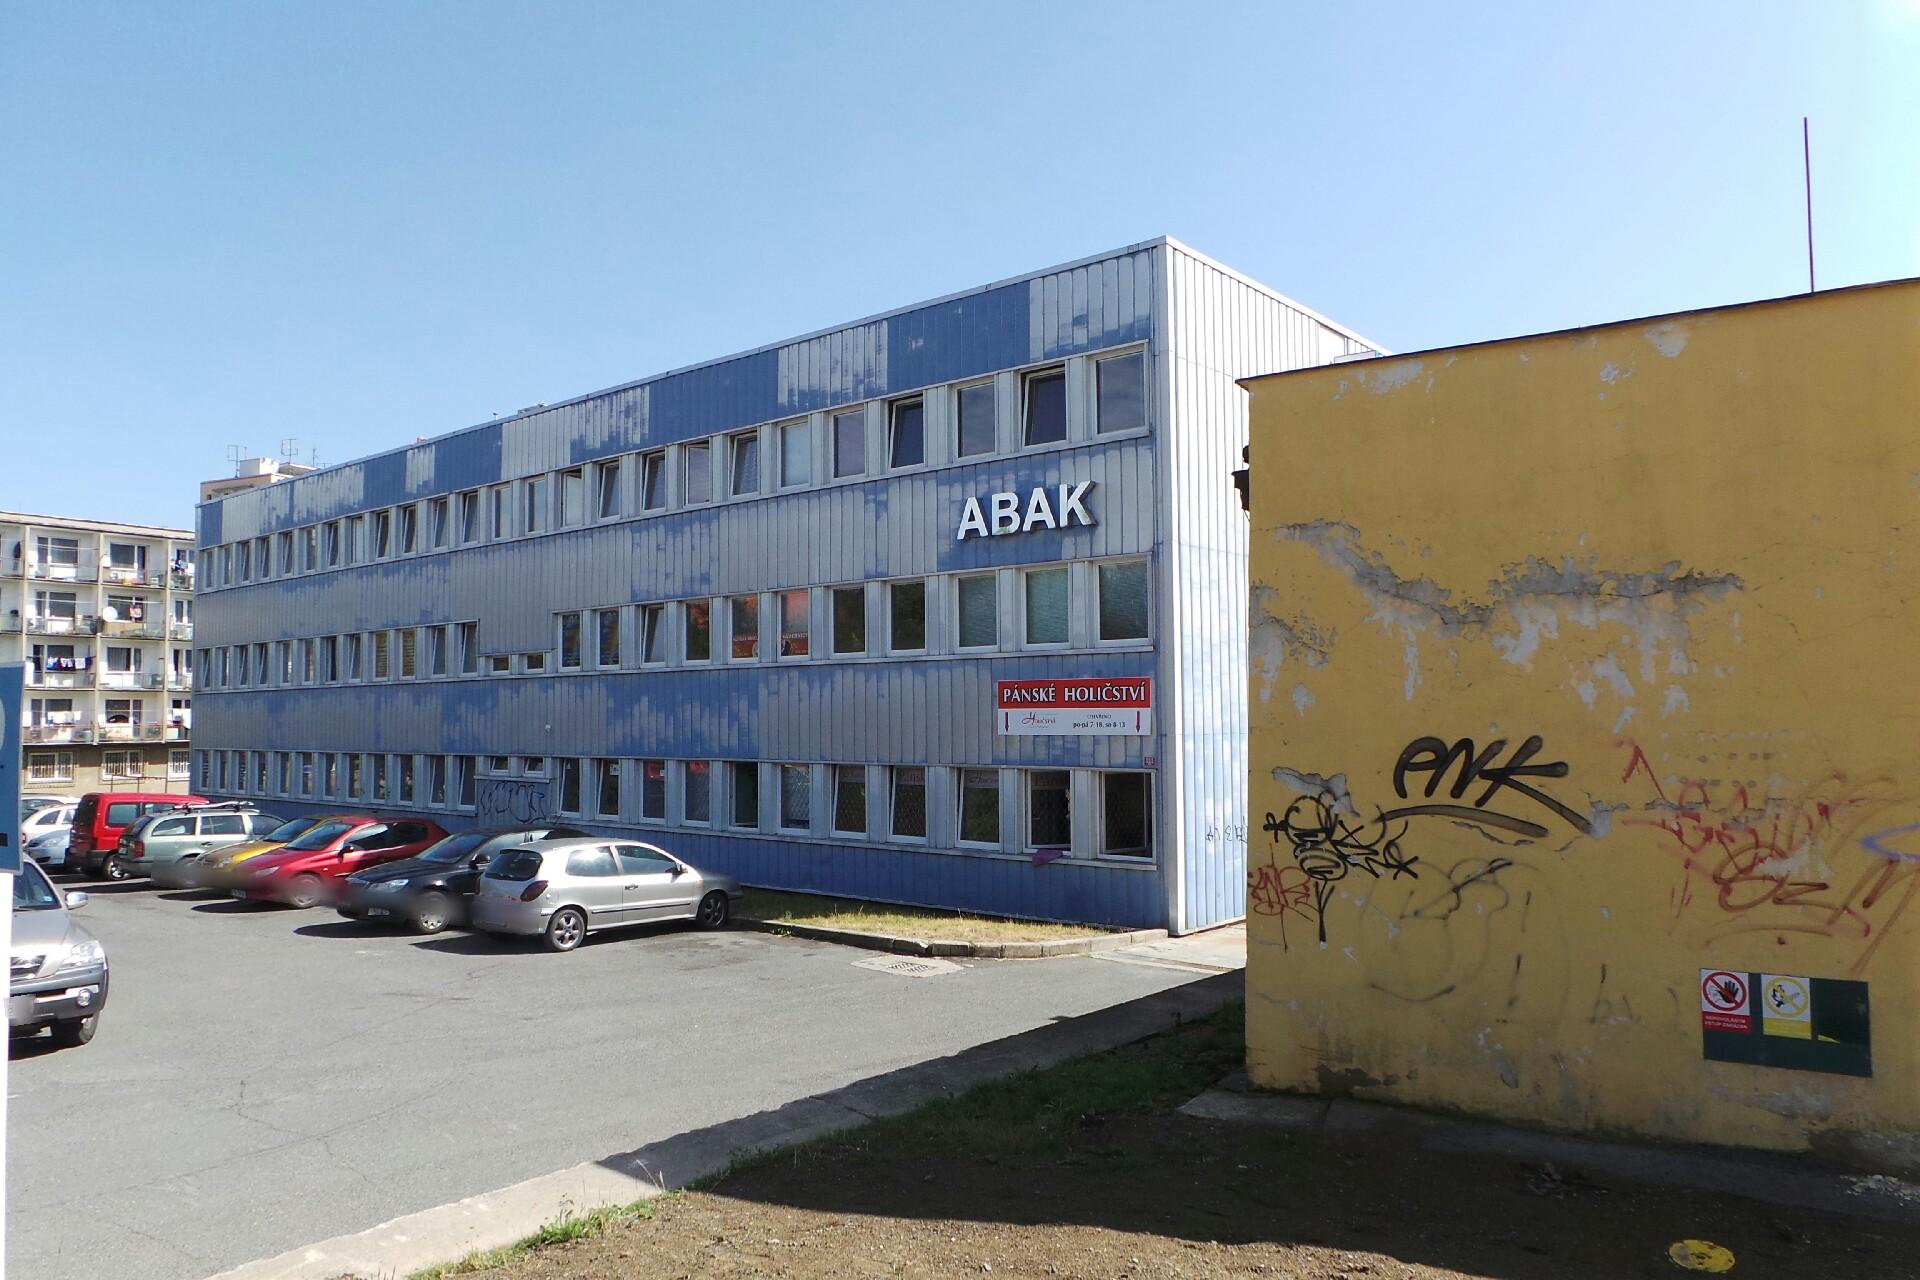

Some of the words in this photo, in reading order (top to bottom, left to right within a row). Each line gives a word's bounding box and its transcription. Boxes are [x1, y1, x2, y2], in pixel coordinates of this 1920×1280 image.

[957, 480, 1097, 540] ABAK
[1003, 683, 1056, 702] PÁNSKÉ
[1064, 682, 1146, 701] HOLIČSTVÍ
